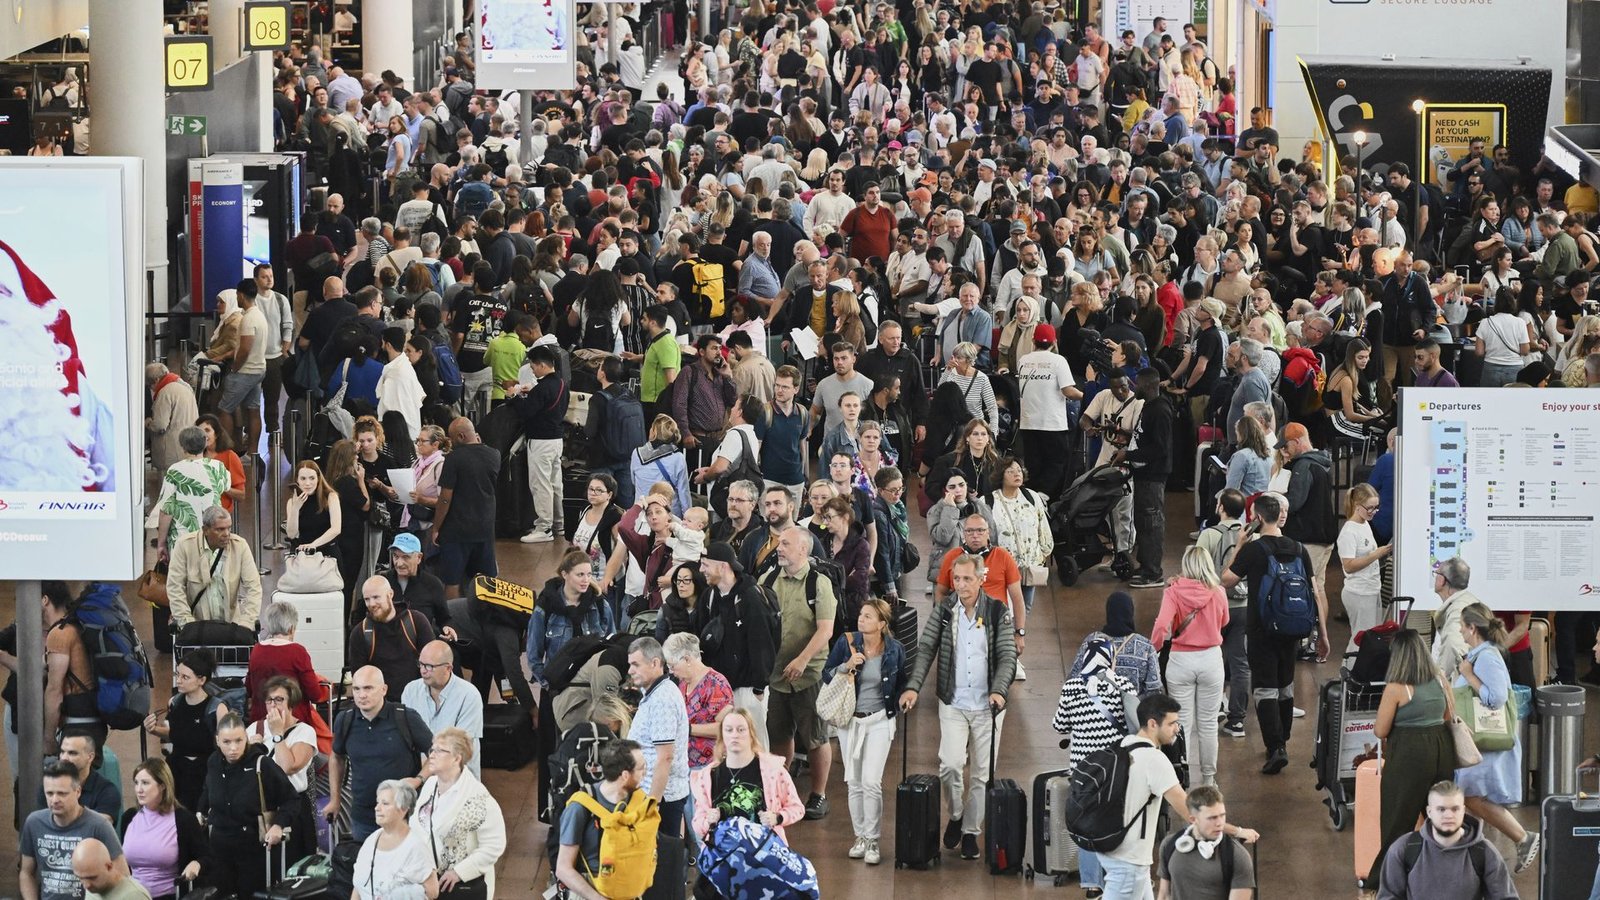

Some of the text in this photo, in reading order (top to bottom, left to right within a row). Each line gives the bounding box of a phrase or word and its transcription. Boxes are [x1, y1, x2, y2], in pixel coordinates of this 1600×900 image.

[255, 20, 281, 40] 08
[173, 58, 203, 80] 07
[1435, 119, 1480, 127] NEED CASH
[1435, 127, 1469, 135] AT YOUR
[1428, 402, 1482, 412] Departures
[1541, 402, 1567, 412] Enjoy
[1569, 404, 1591, 412] your
[38, 502, 106, 510] FINNAIR
[0, 531, 48, 542] CDecaux
[496, 582, 533, 599] NORTH
[496, 590, 517, 600] THE
[1345, 722, 1375, 733] corendo
[37, 838, 60, 850] FINEST
